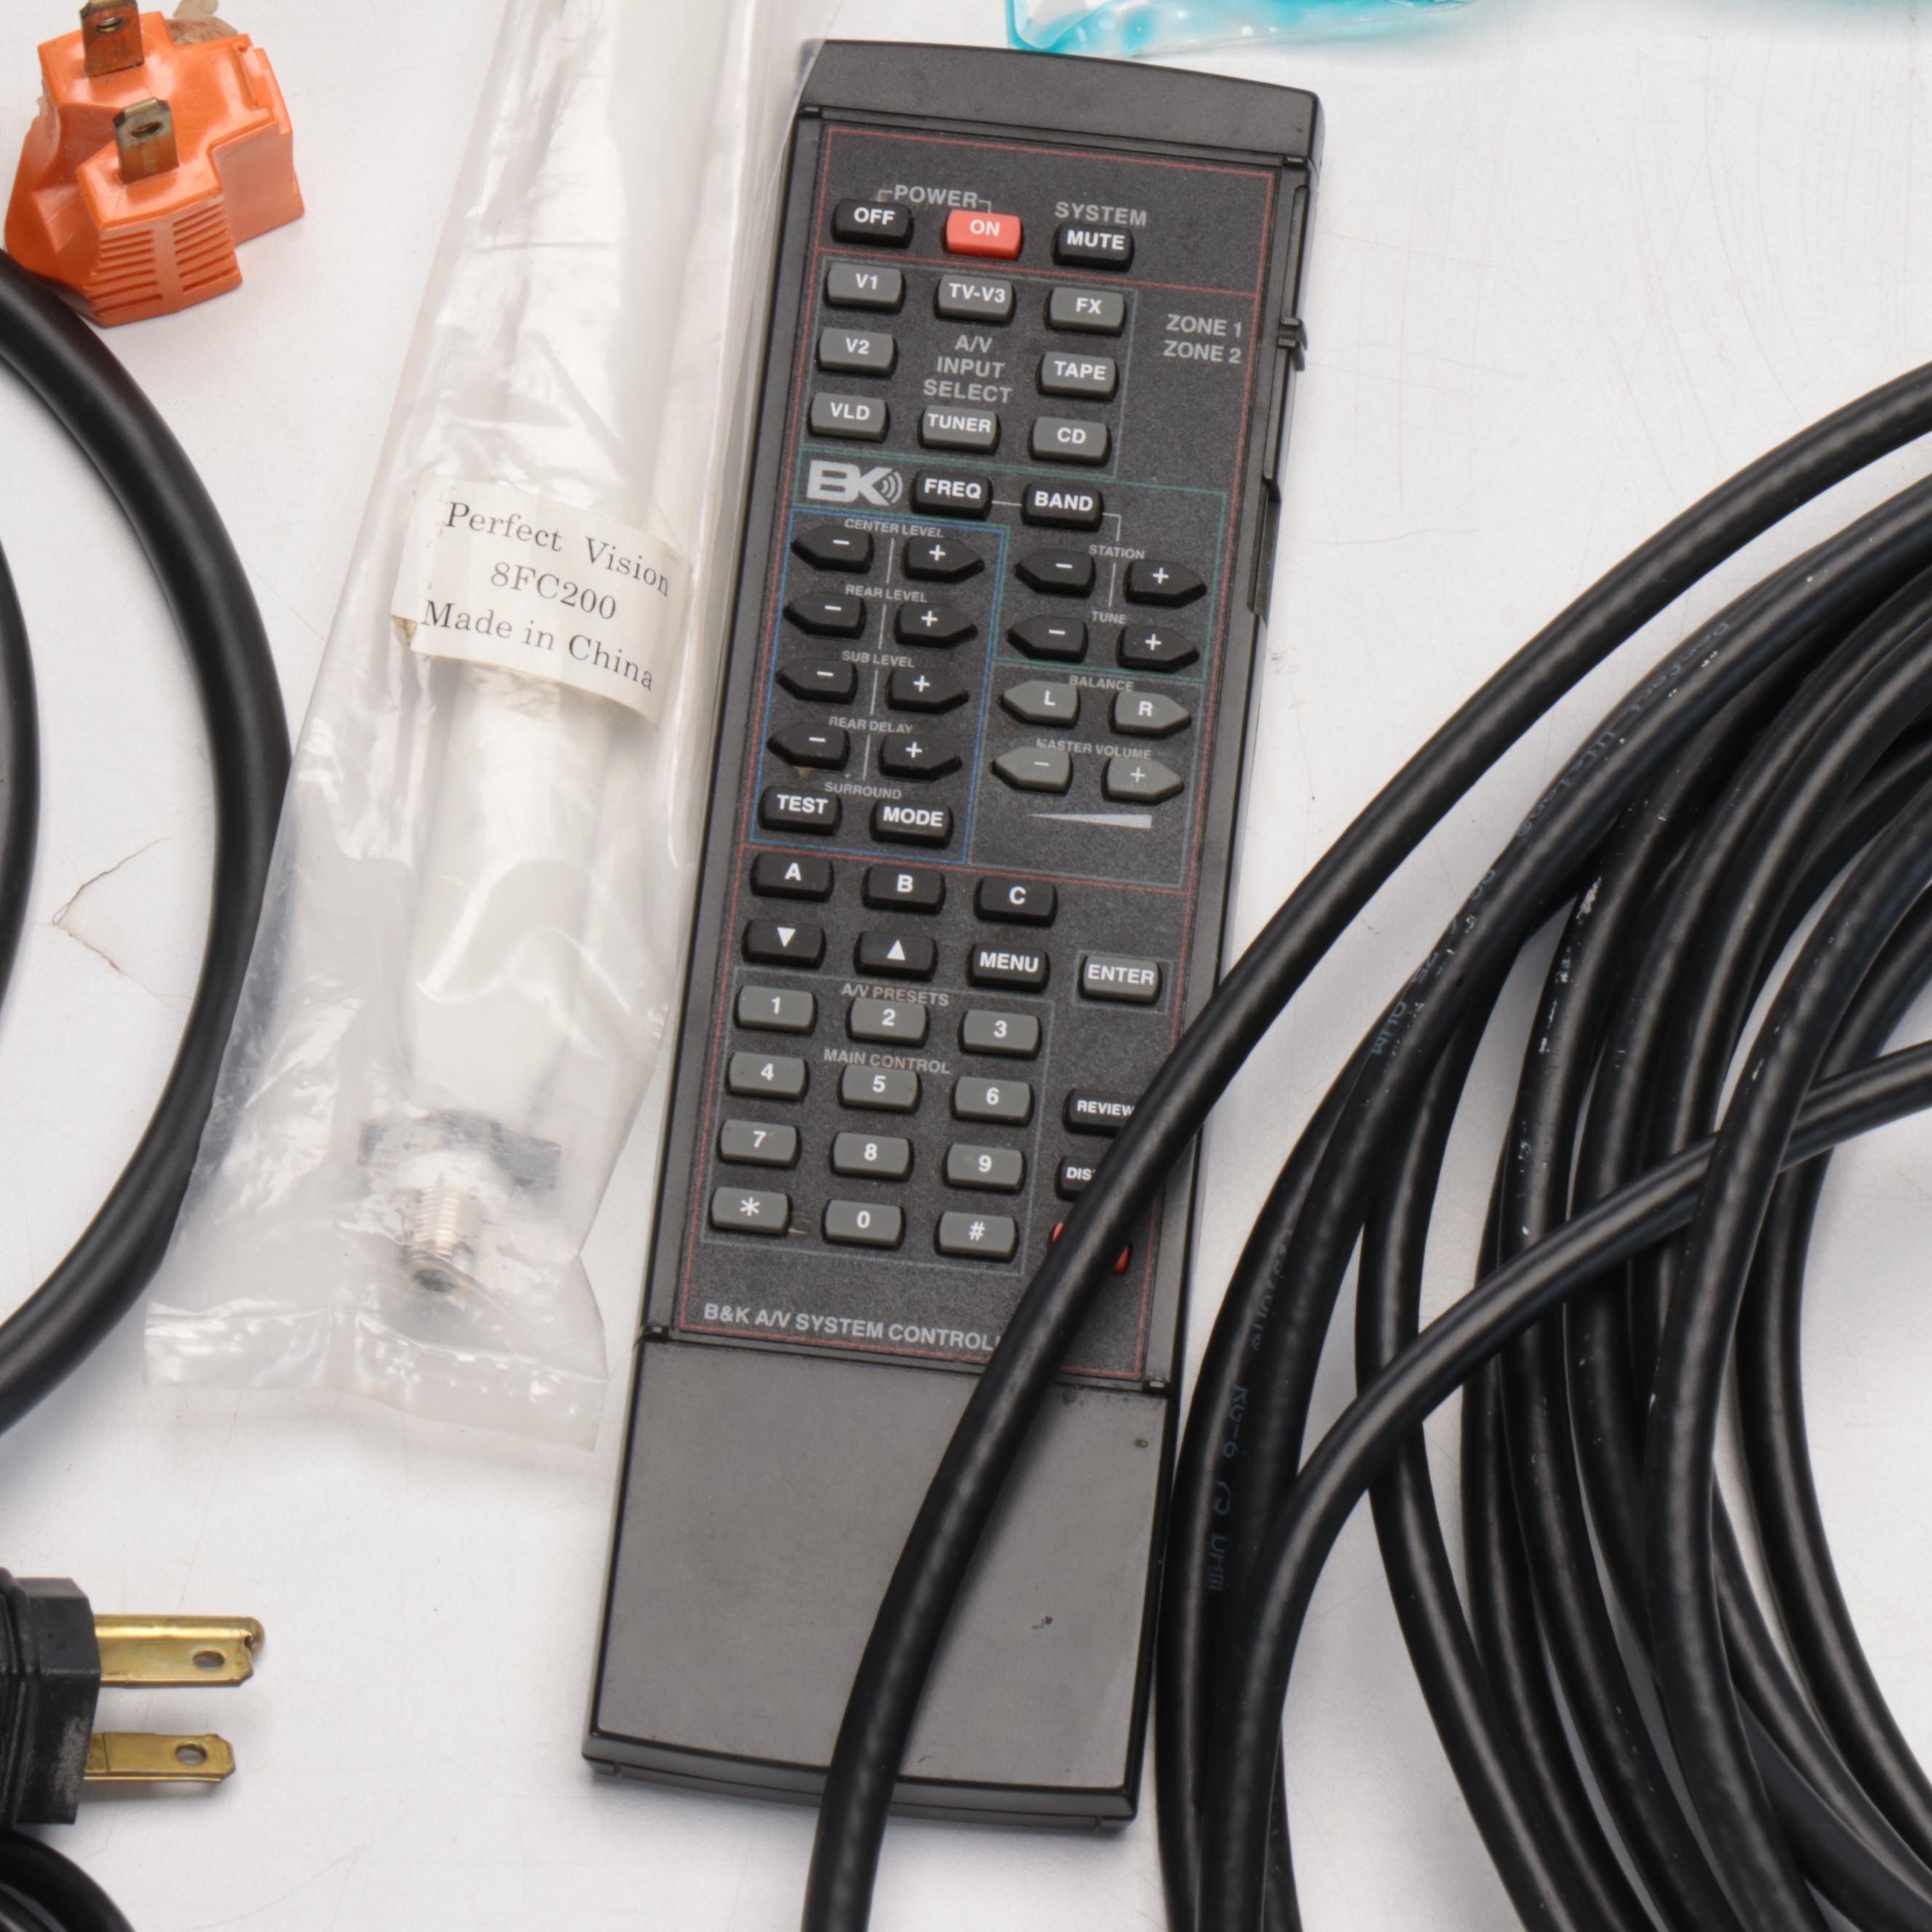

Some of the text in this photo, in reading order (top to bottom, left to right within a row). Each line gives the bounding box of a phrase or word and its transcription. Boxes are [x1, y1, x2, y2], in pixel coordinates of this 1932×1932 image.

[894, 184, 978, 209] POWER
[854, 207, 895, 225] OFF
[1055, 201, 1146, 226] SYSTEM
[970, 220, 1000, 237] ON
[1067, 231, 1125, 251] MUTE
[855, 273, 878, 290] V1
[949, 283, 1005, 303] TV-V3
[1076, 298, 1101, 315] FX
[1166, 314, 1241, 338] ZONE 1
[846, 338, 869, 355] V2
[956, 335, 992, 353] A/V
[1163, 340, 1241, 364] ZONE 2
[937, 357, 1005, 378] INPUT
[1054, 362, 1106, 381] TAPE
[923, 379, 1012, 403] SELECT
[831, 403, 869, 420] VLD
[927, 414, 991, 434] TUNER
[1057, 428, 1086, 444] CD
[925, 479, 981, 500] FREQ
[1035, 492, 1093, 511] BAND
[845, 519, 943, 538] CENTER LEVEL
[445, 500, 669, 597] Perfect Vision
[1089, 544, 1144, 559] STATION
[490, 562, 617, 620] 8FC200
[845, 585, 927, 603] REAR LEVEL
[1093, 611, 1126, 625] TUNE
[420, 600, 653, 692] Made in China
[842, 650, 914, 668] SUB LEVEL
[1070, 676, 1133, 692] BALANCE
[1045, 691, 1055, 706] L
[1139, 701, 1152, 716] R
[829, 716, 913, 734] REAR DELAY
[1037, 739, 1151, 759] MASTER VOLUME
[825, 782, 901, 799] SURROUND
[777, 794, 828, 815] TEST
[883, 806, 943, 827] MODE
[785, 863, 801, 881] A
[897, 875, 913, 893] B
[1010, 887, 1026, 905] C
[980, 952, 1039, 973] MENU
[1087, 964, 1155, 986] ENTER
[842, 983, 949, 1007] A/V PRESETS
[771, 997, 781, 1014] 1
[882, 1010, 895, 1026] 2
[994, 1021, 1007, 1038] 3
[823, 1049, 951, 1075] MAIN CONTROL
[761, 1063, 774, 1080] 4
[873, 1076, 886, 1093] 5
[986, 1087, 999, 1105] 6
[753, 1131, 766, 1148] 7
[864, 1143, 877, 1160] 8
[978, 1156, 991, 1173] 9
[1066, 1167, 1095, 1181] DIS
[857, 1211, 870, 1229] 0
[704, 1303, 751, 1322] B&K
[754, 1308, 792, 1326] A/V
[795, 1313, 884, 1338] SYSTEM
